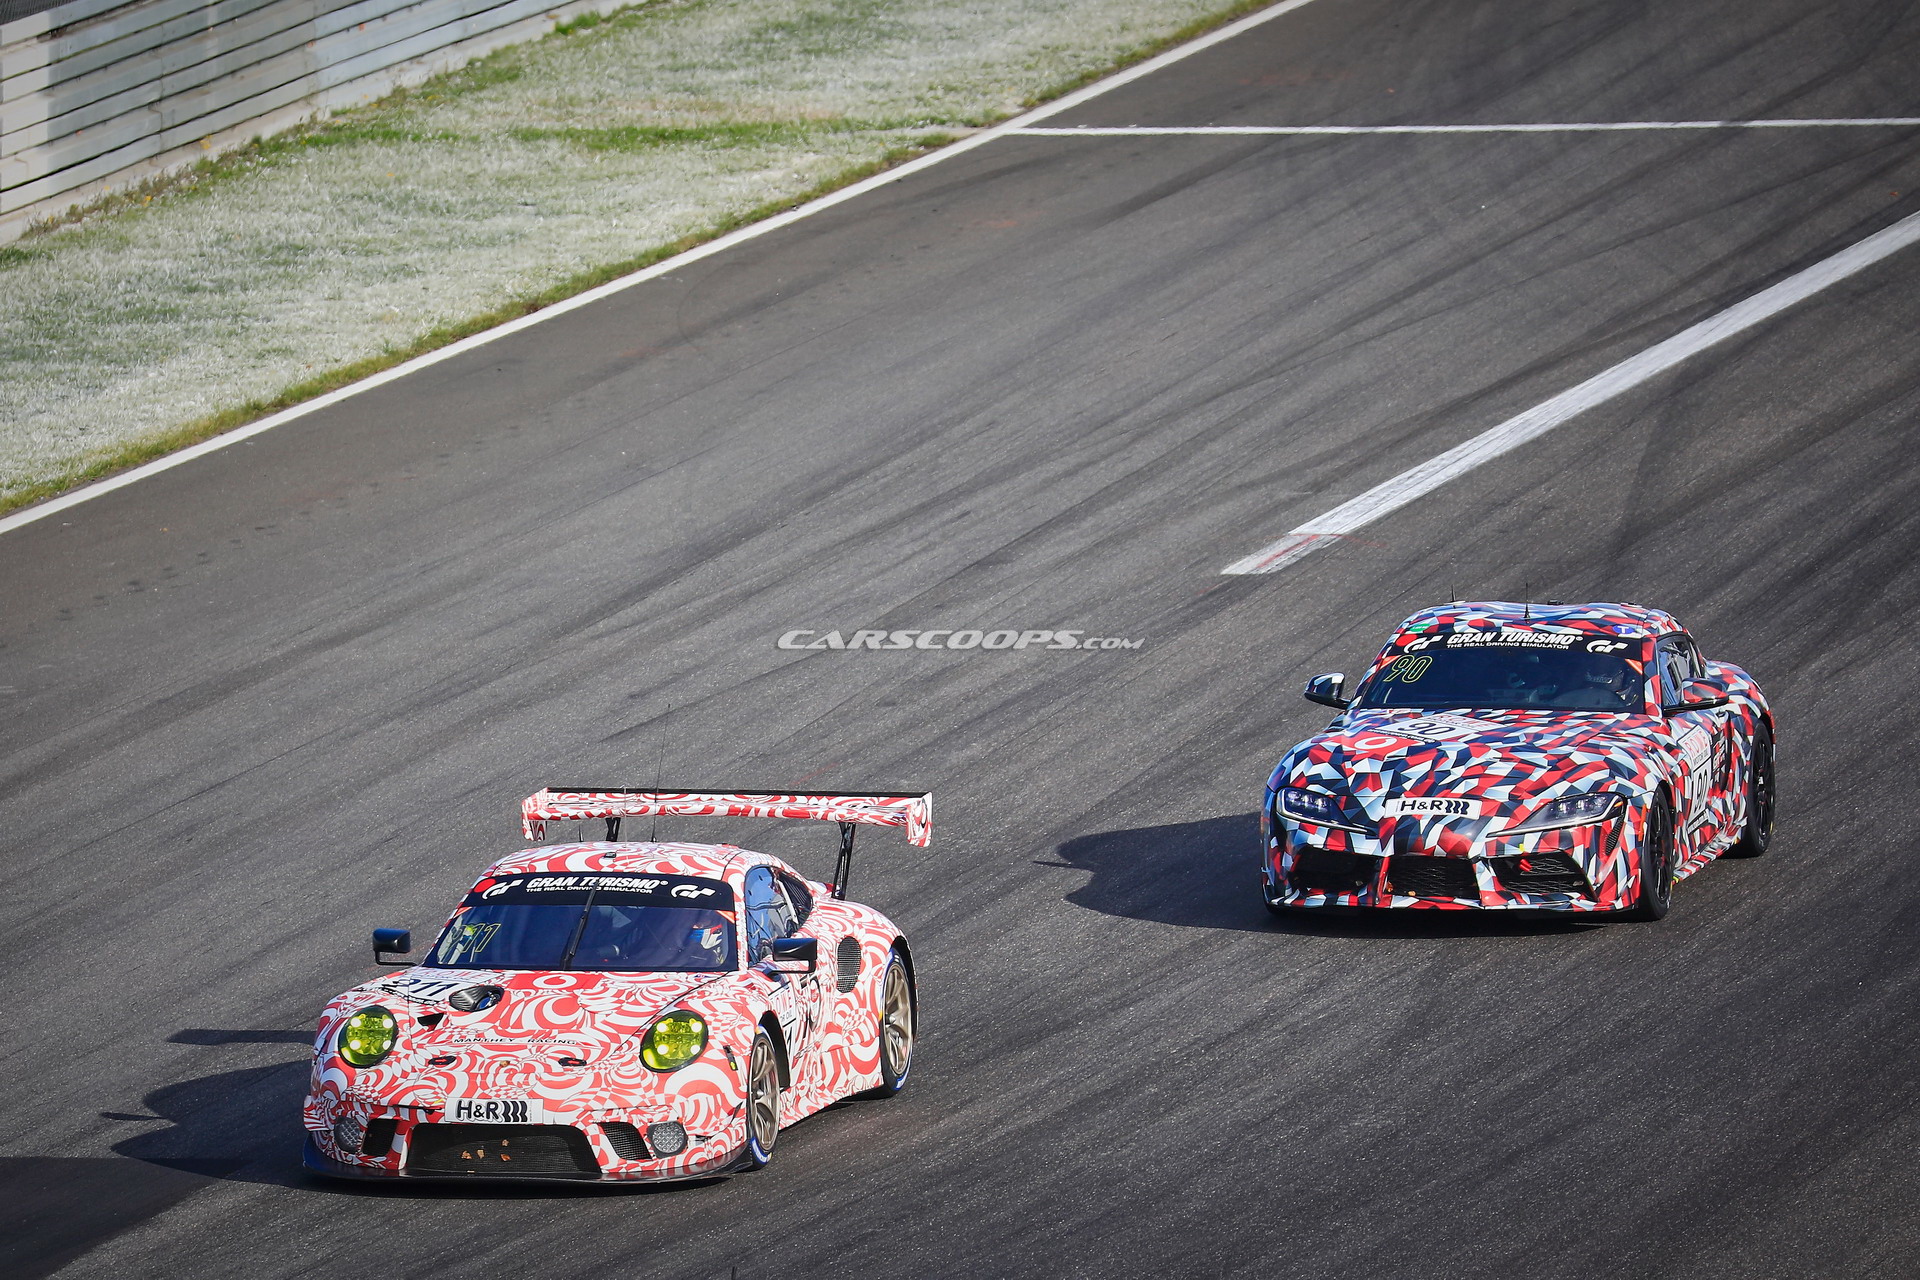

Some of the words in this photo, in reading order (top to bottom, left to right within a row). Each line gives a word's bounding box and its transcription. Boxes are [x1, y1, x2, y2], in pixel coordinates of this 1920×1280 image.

[1447, 632, 1497, 644] GRAN
[1521, 642, 1569, 650] SIMULATOR
[1383, 655, 1433, 683] 90
[1398, 722, 1456, 736] 90
[527, 876, 579, 889] GRAN
